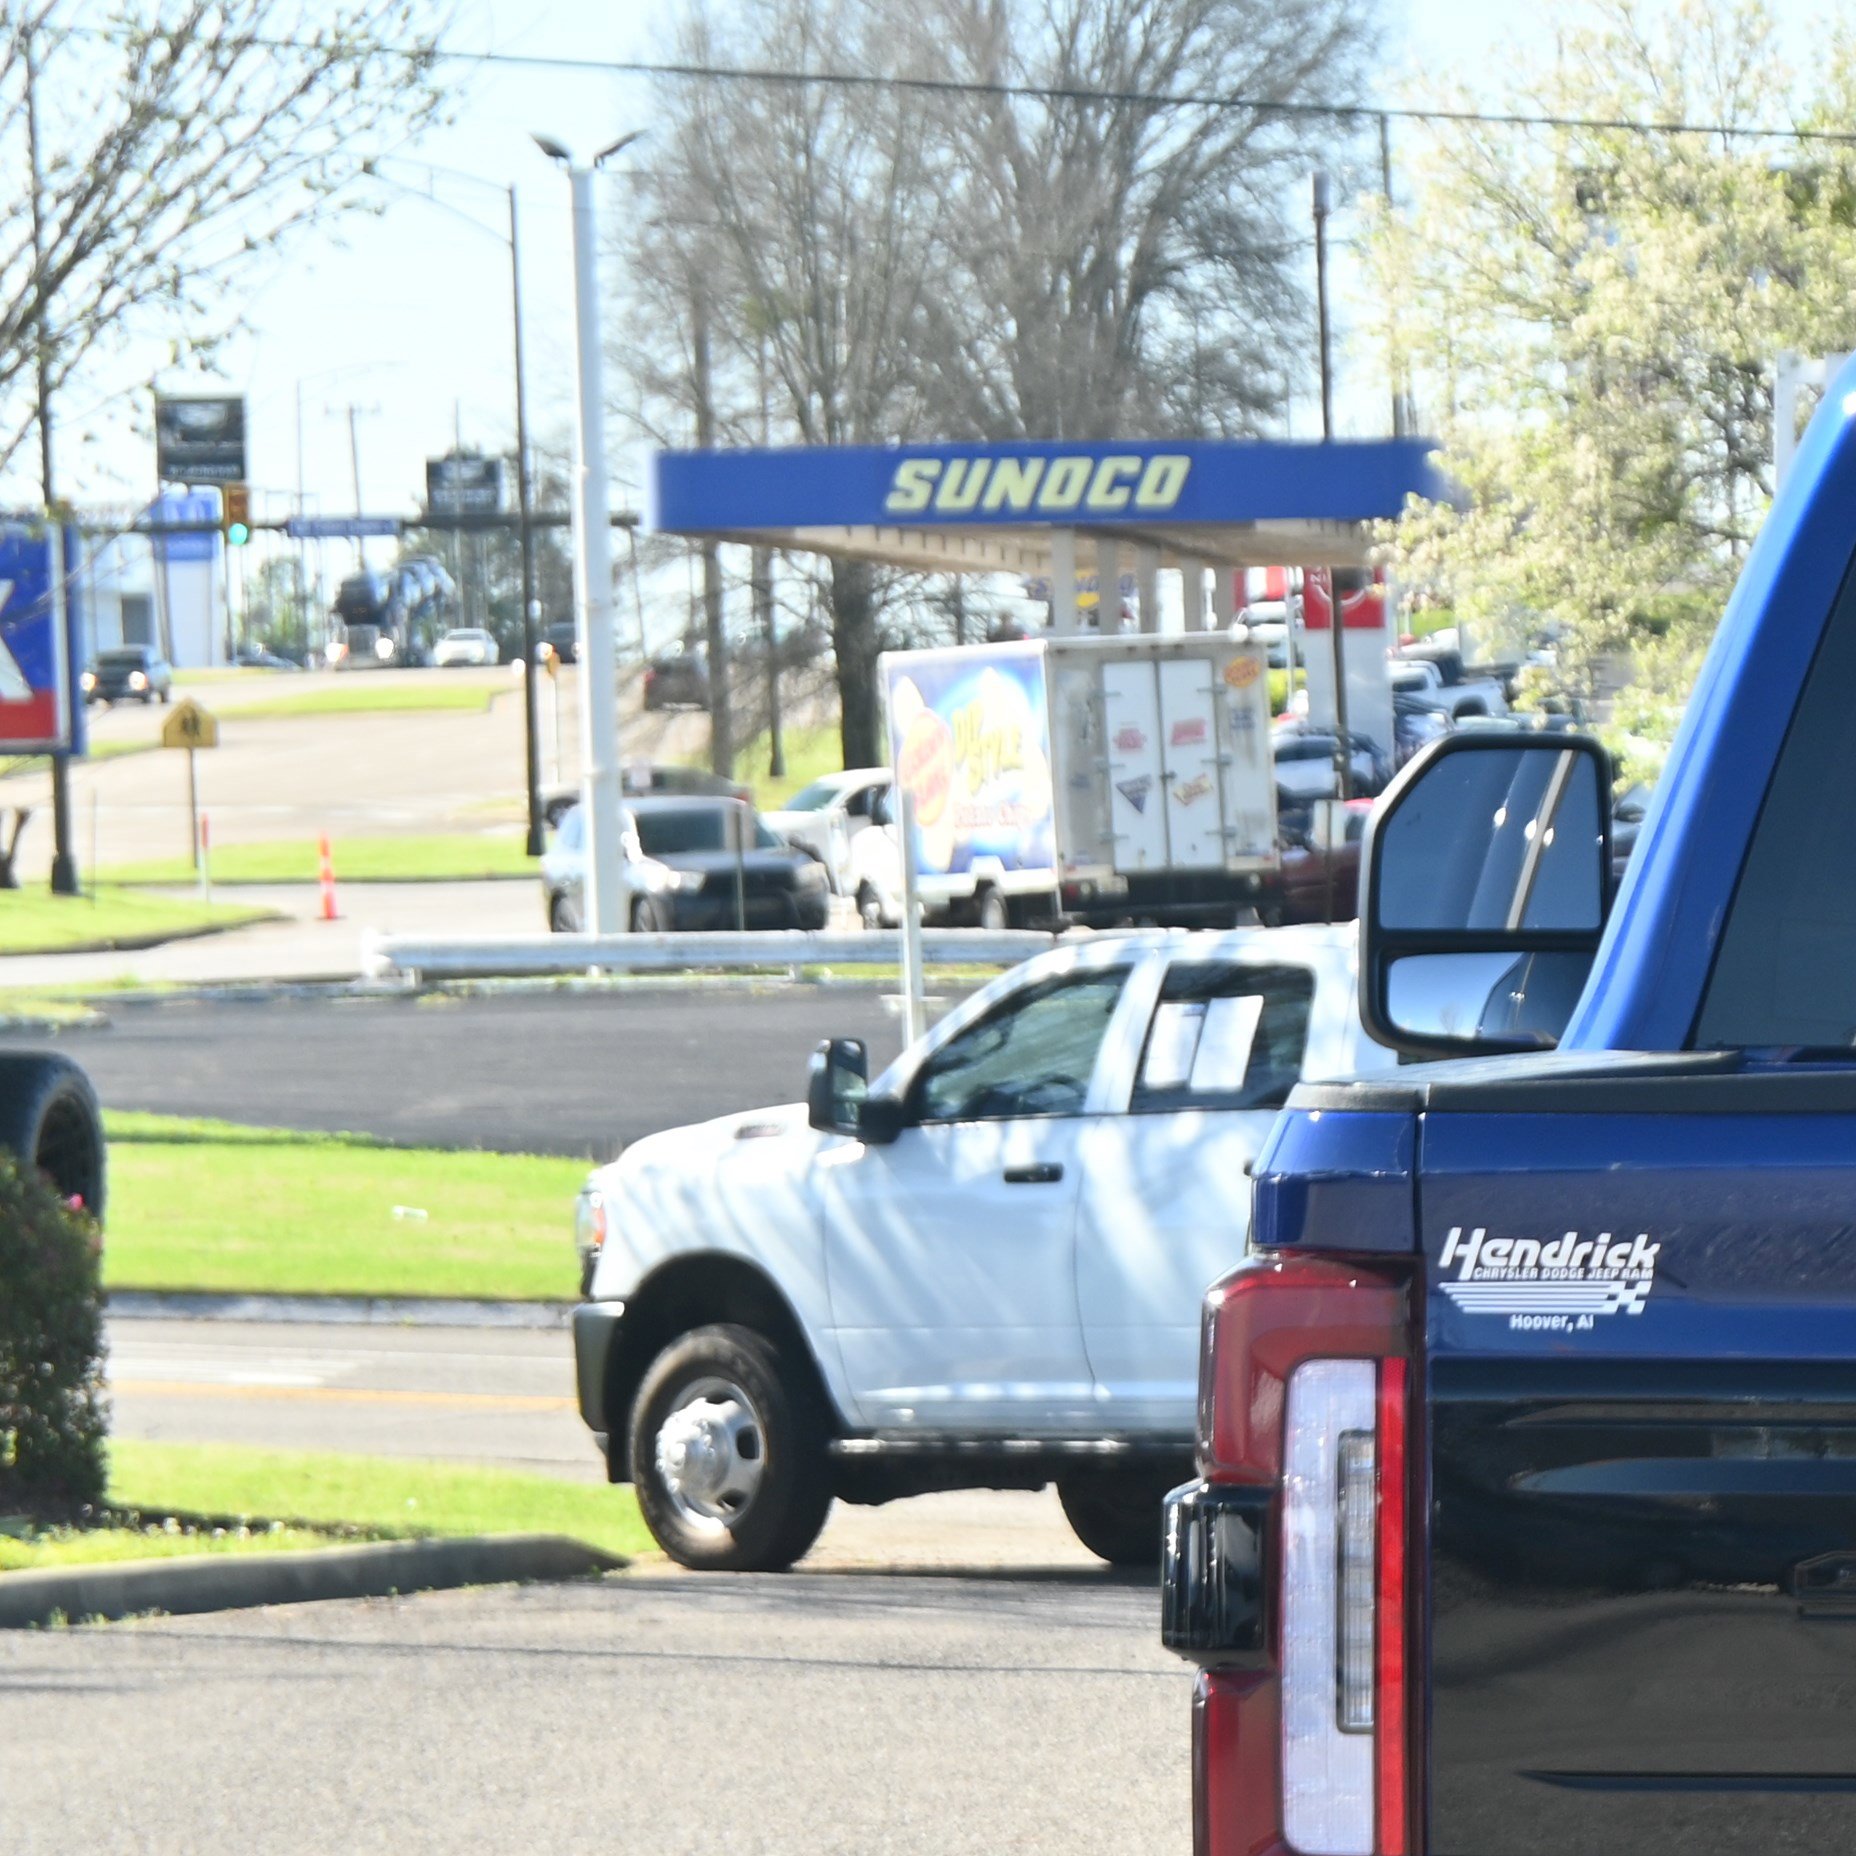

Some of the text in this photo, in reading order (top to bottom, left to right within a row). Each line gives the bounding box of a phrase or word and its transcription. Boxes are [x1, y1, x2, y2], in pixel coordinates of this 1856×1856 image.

[885, 455, 1192, 511] SUNOCO
[1438, 1226, 1661, 1281] Hendrick
[1473, 1266, 1654, 1281] CHRYSLER DODGE JEEP RAM
[1509, 1313, 1573, 1333] Hoover,
